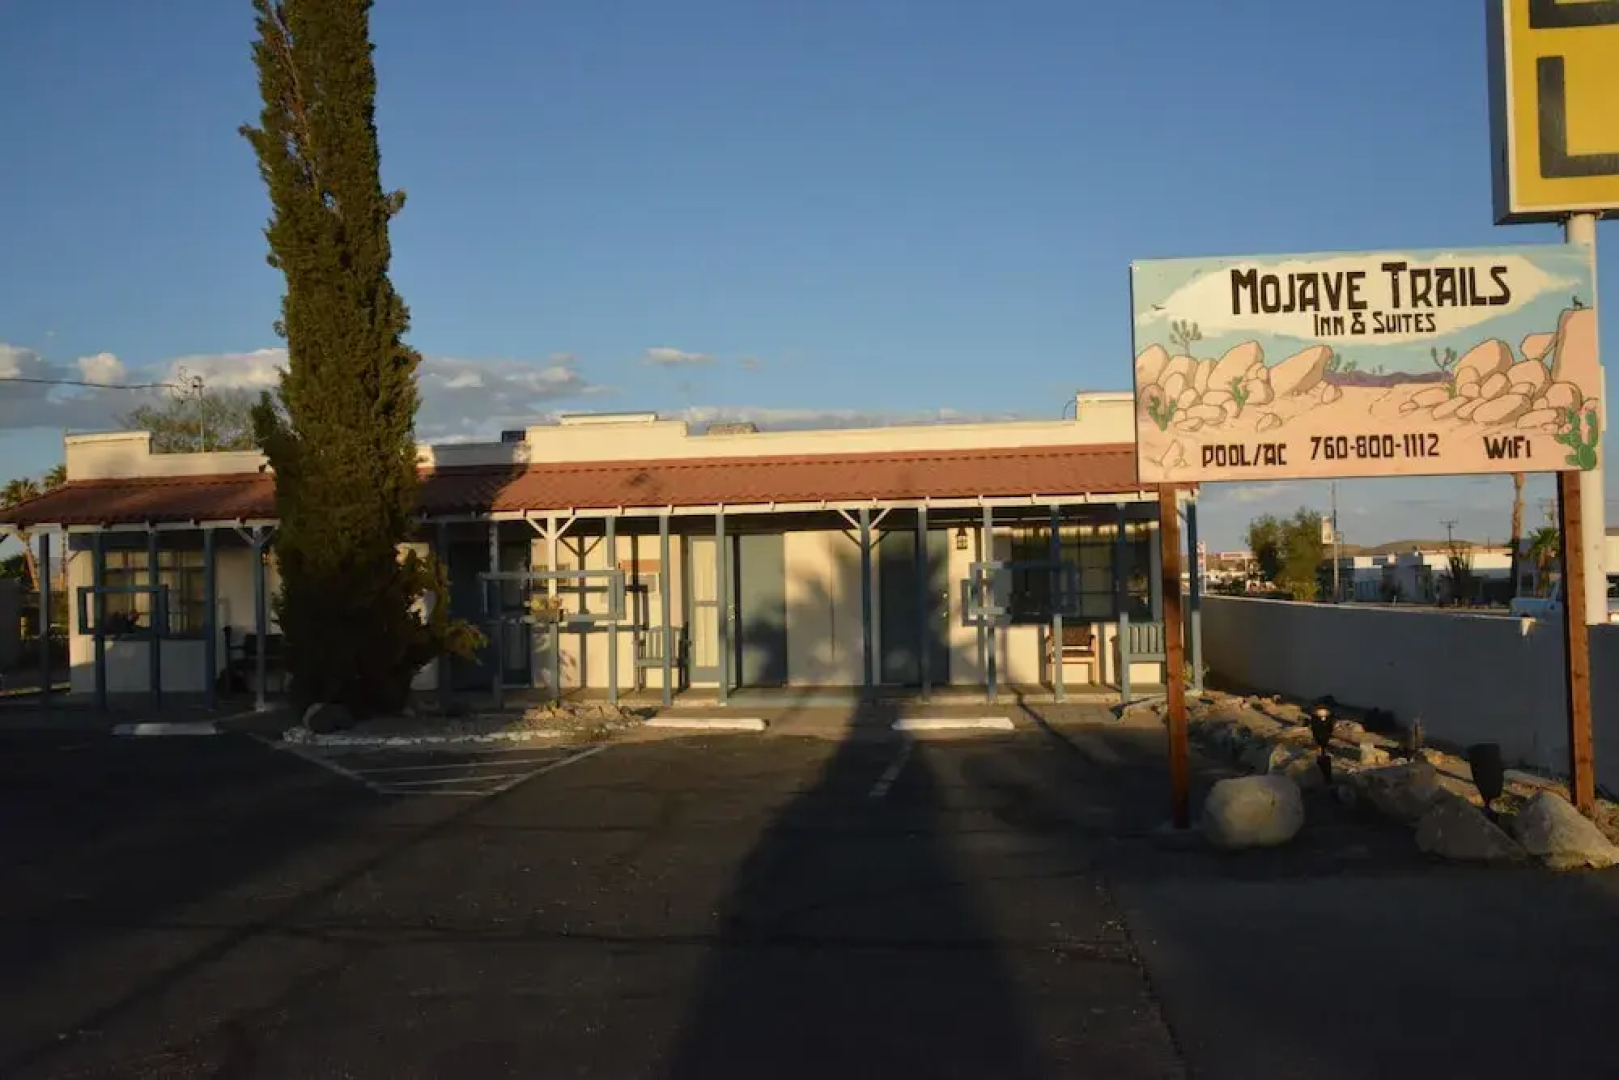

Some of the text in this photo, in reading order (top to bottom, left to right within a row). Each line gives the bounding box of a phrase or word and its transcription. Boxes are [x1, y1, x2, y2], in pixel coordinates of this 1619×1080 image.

[1230, 261, 1511, 315] MOJAVE TRAILS
[1314, 311, 1437, 337] INN & SUITES
[1202, 443, 1287, 468] POOL/AC
[1310, 433, 1440, 461] 760-800-1112
